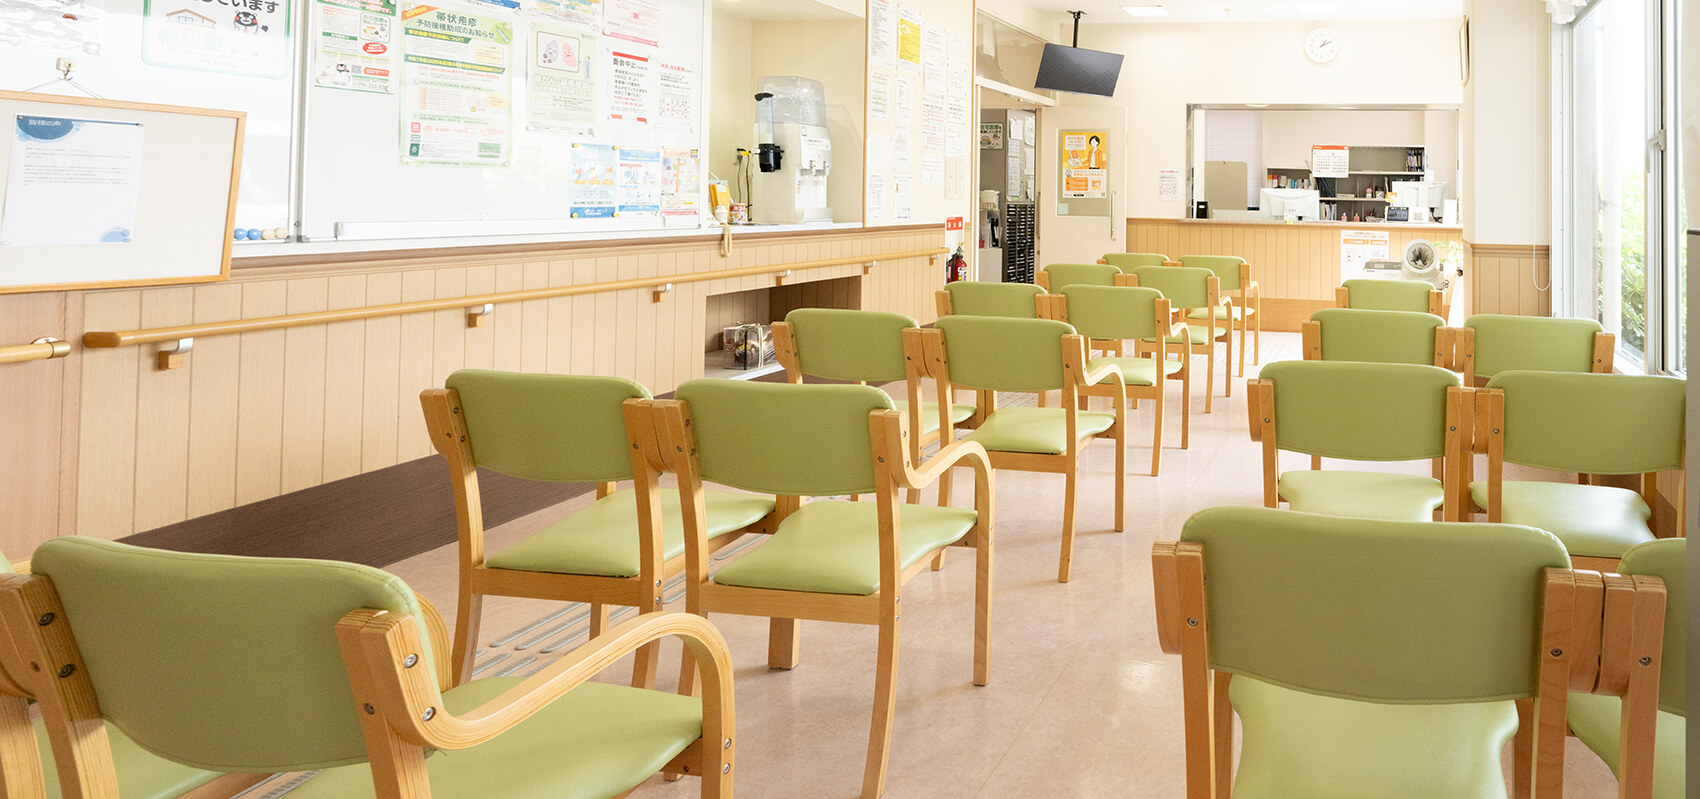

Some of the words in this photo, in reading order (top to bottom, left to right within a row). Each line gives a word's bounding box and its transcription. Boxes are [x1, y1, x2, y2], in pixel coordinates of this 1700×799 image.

[436, 11, 478, 27] 帯状疱疹
[416, 18, 495, 39] 予防接種助成のお知らせ
